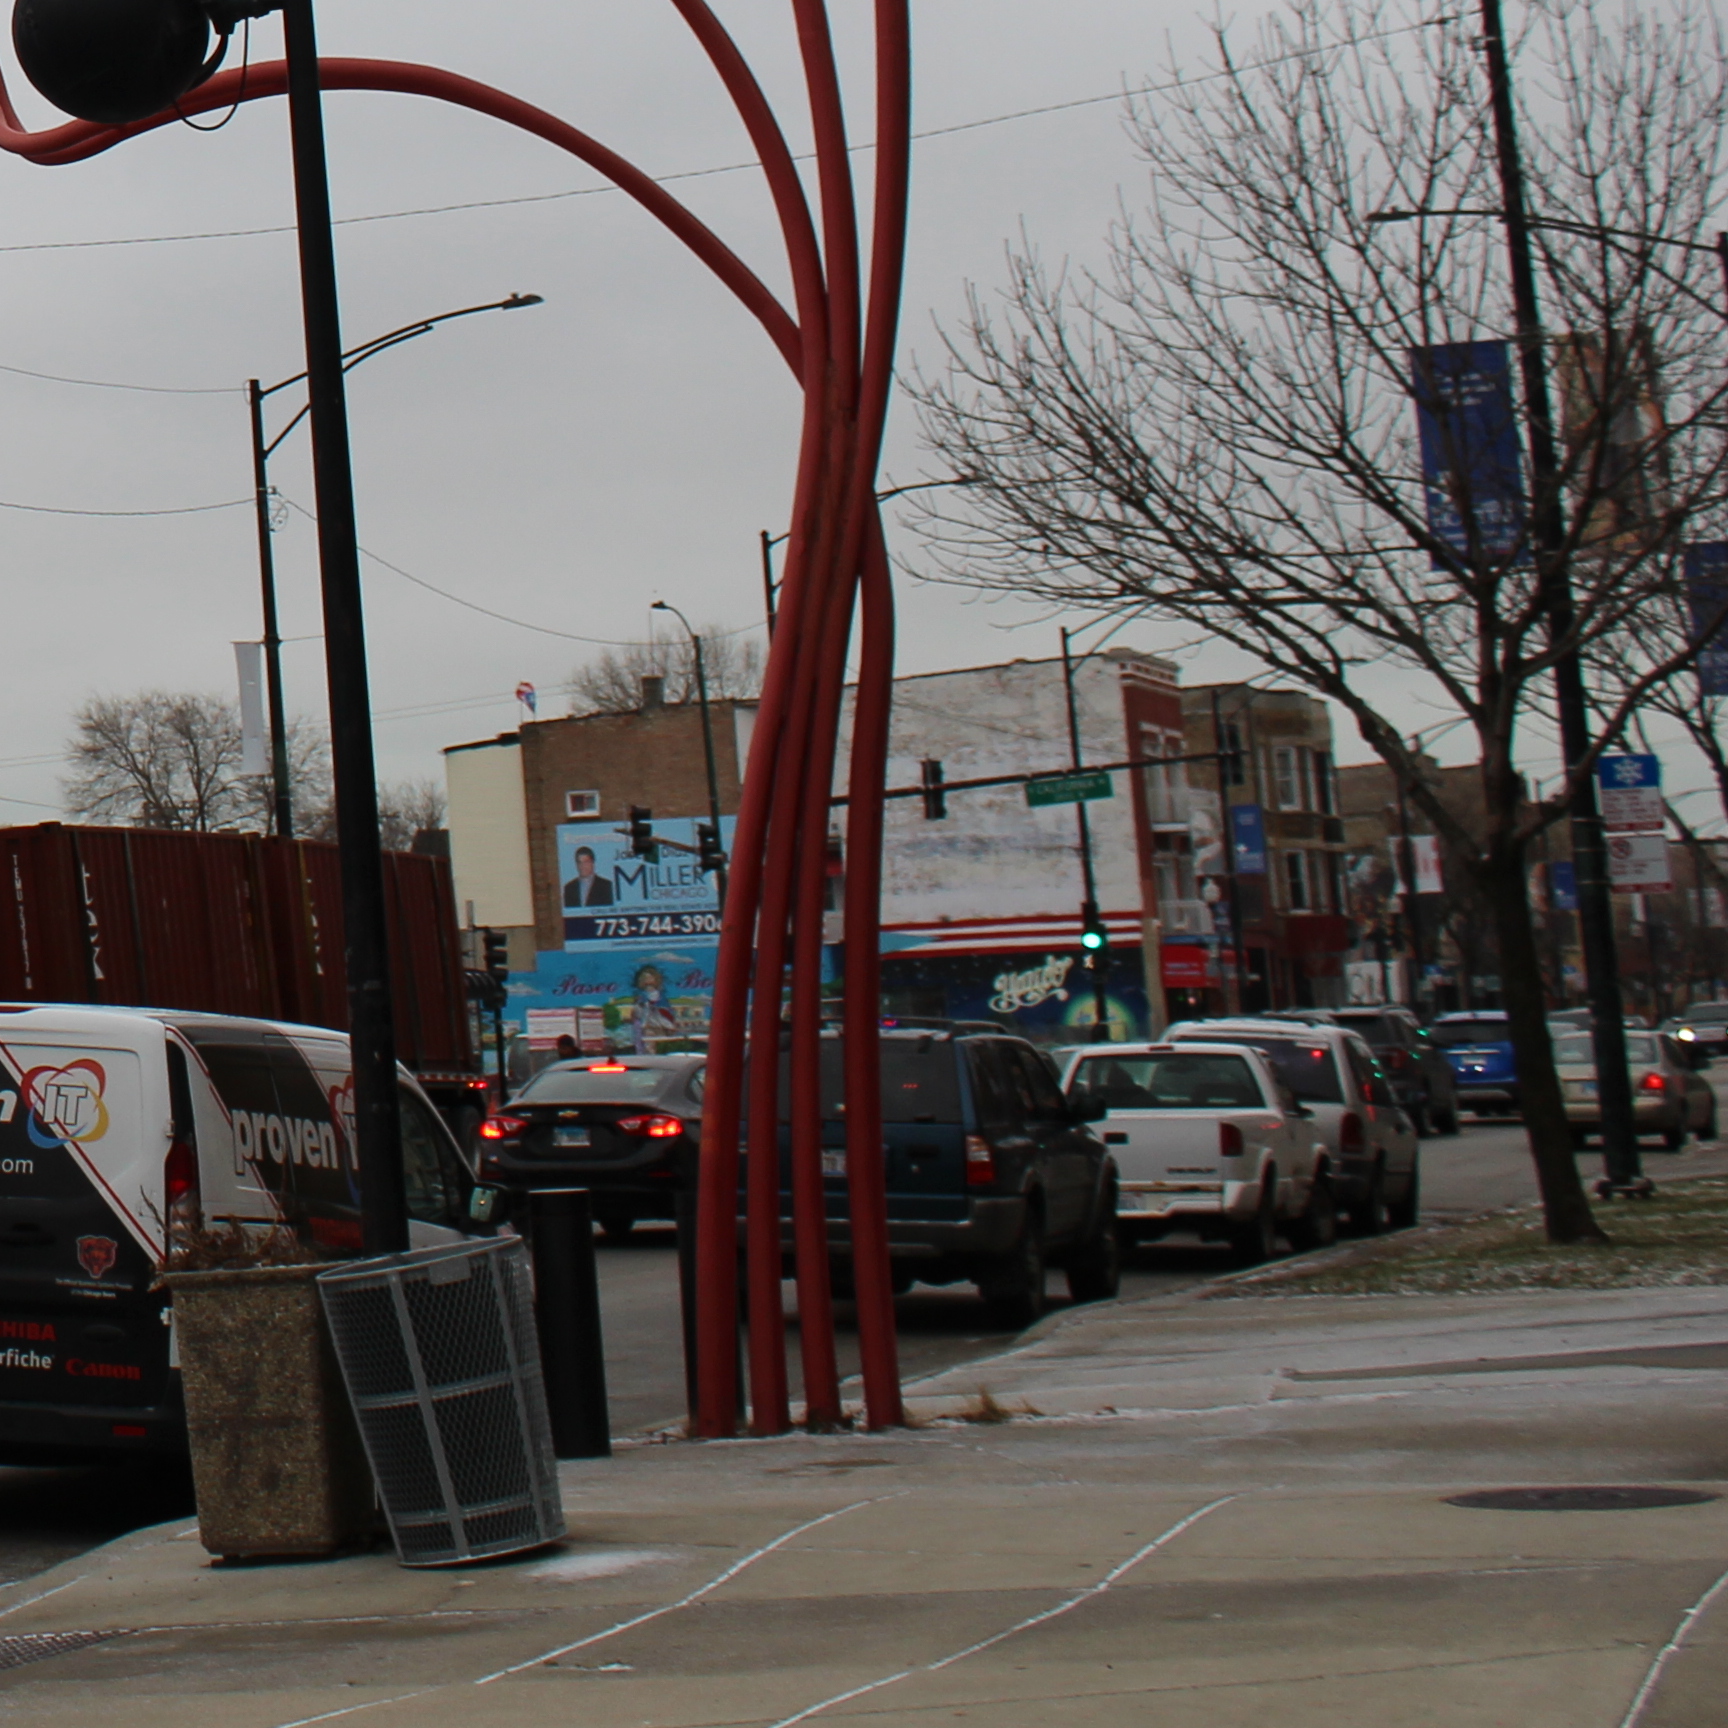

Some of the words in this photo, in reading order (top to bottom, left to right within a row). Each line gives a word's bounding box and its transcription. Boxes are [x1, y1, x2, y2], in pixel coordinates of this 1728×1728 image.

[614, 864, 705, 901] MILLER
[651, 887, 708, 900] CHICAGO
[552, 974, 619, 996] Paseo
[44, 1084, 89, 1127] IT
[231, 1108, 340, 1176] proven
[64, 1358, 141, 1381] Canon
